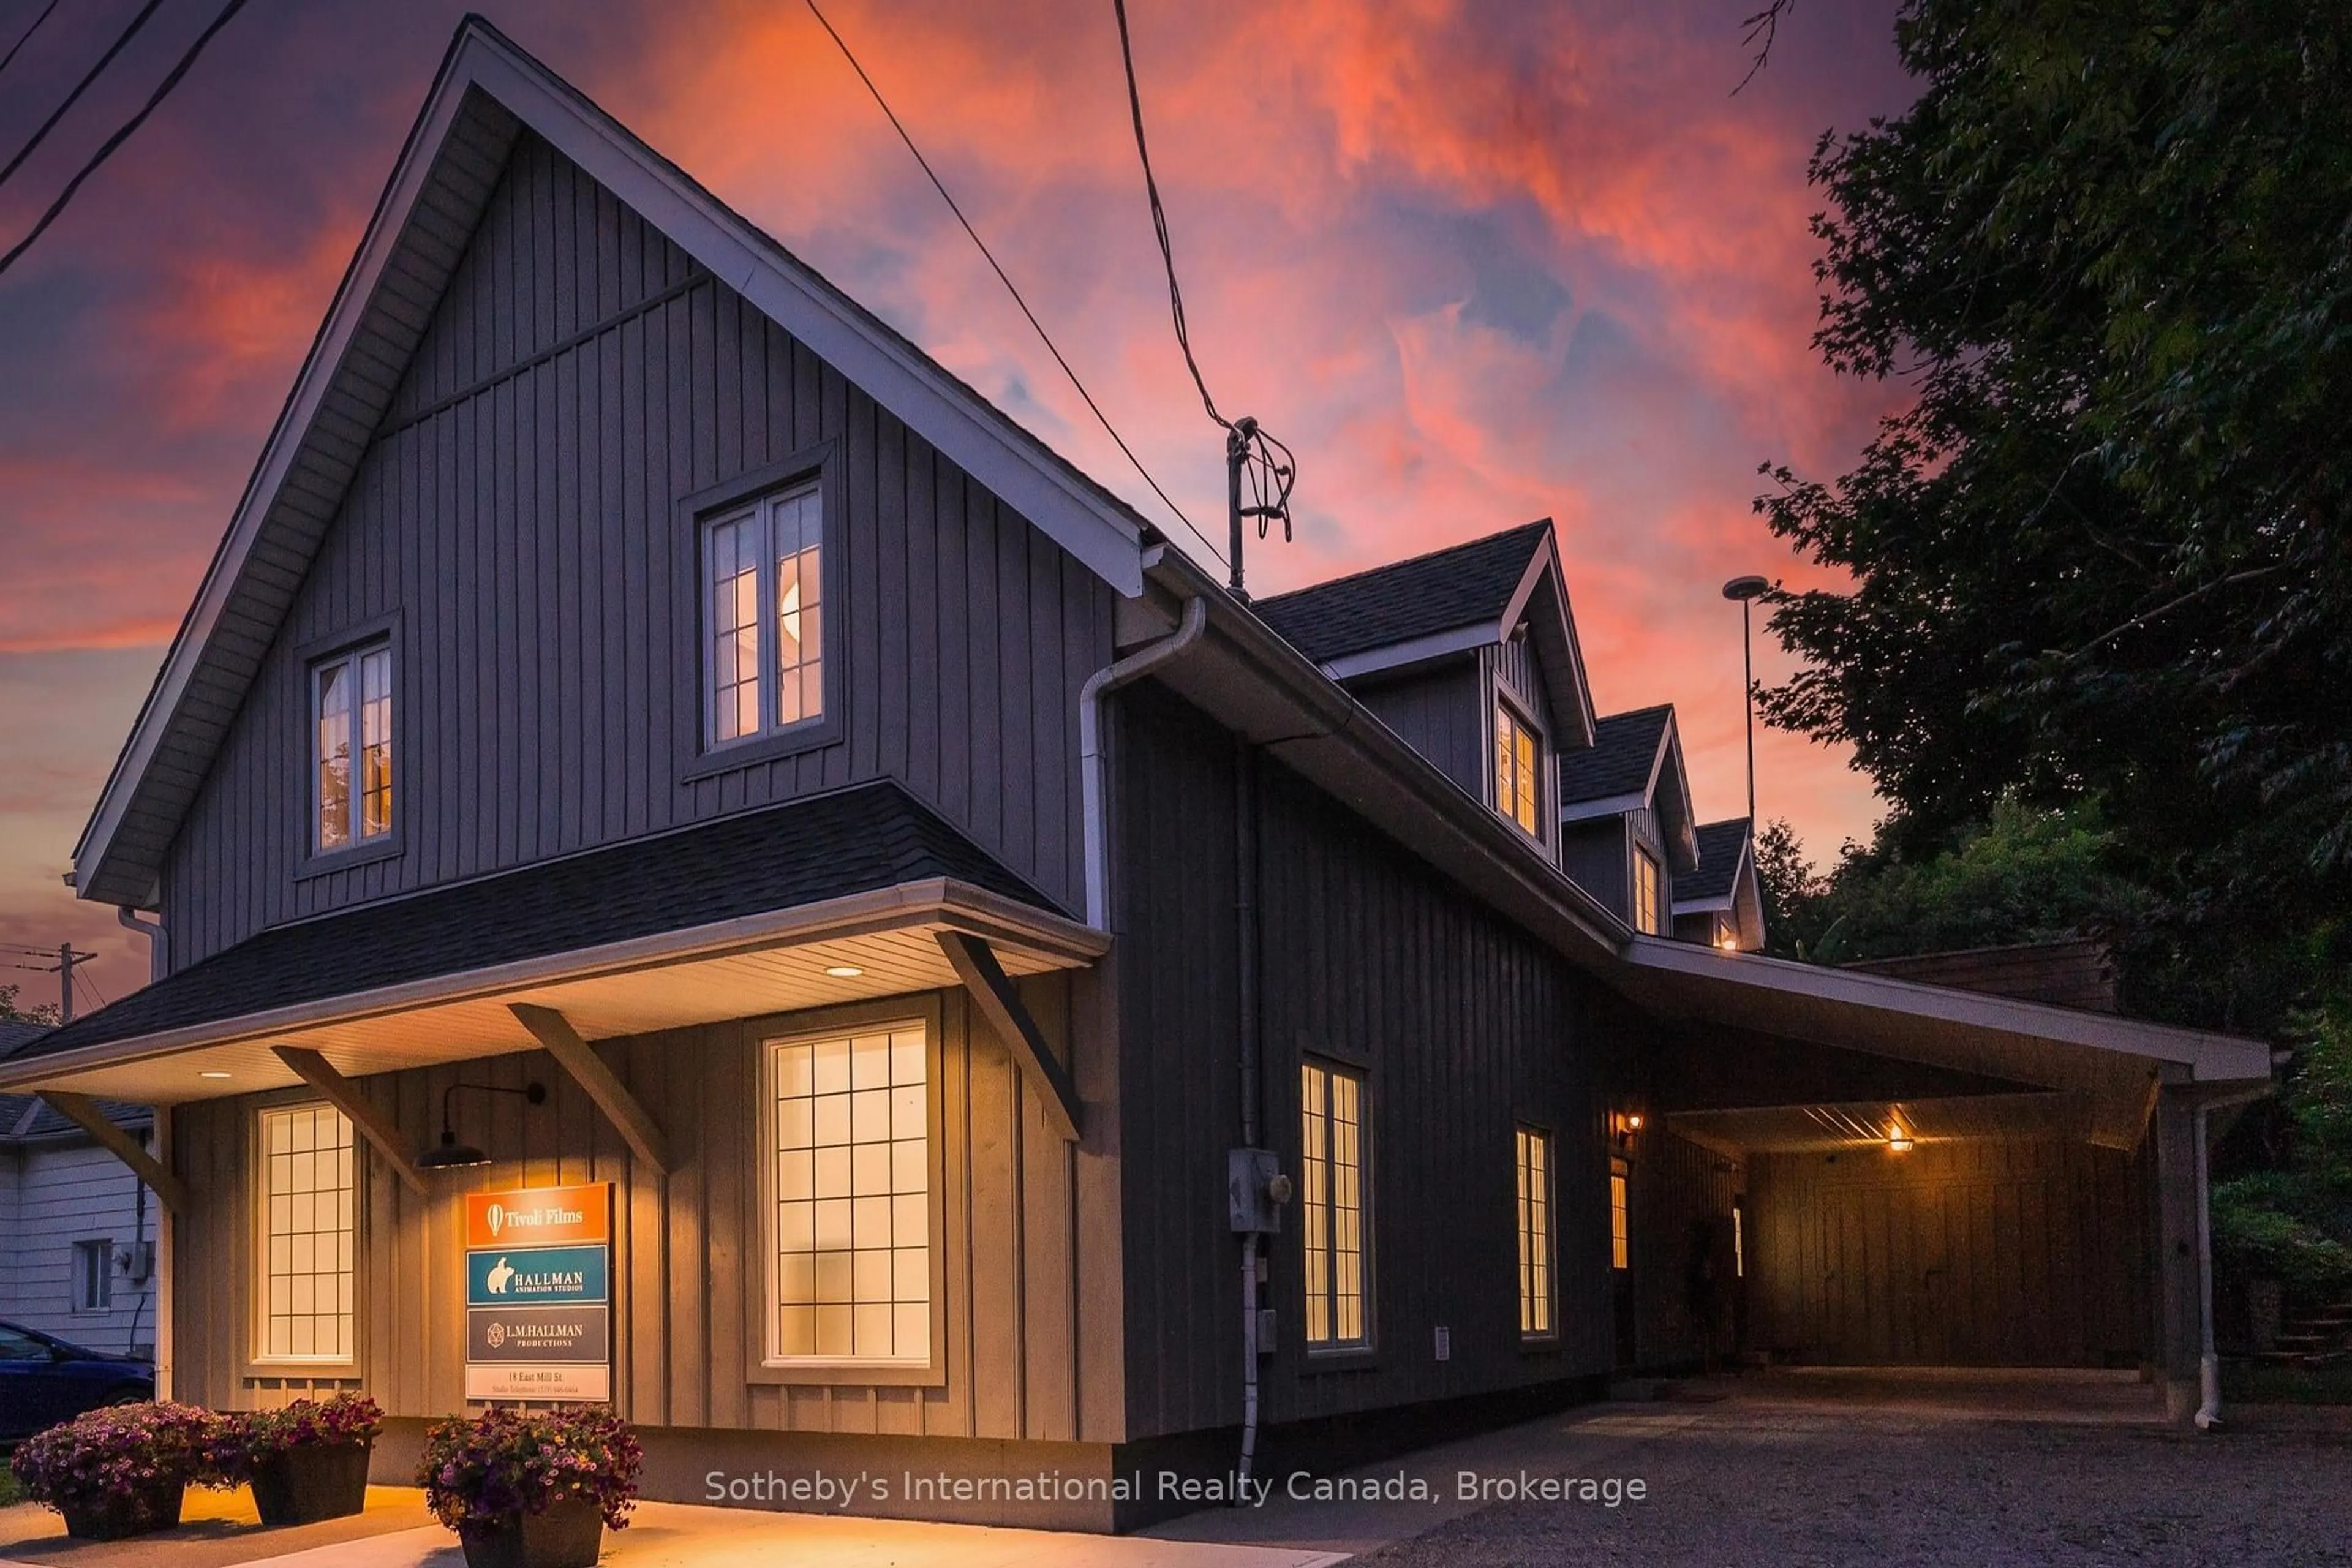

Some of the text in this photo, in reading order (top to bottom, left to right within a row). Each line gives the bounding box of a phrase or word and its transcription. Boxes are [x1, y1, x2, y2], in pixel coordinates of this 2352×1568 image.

[505, 1208, 583, 1227] Tivoli Films
[515, 1272, 582, 1286] HALLMAN
[509, 1372, 518, 1382] 18
[519, 1372, 534, 1382] East
[537, 1372, 552, 1382] Mill
